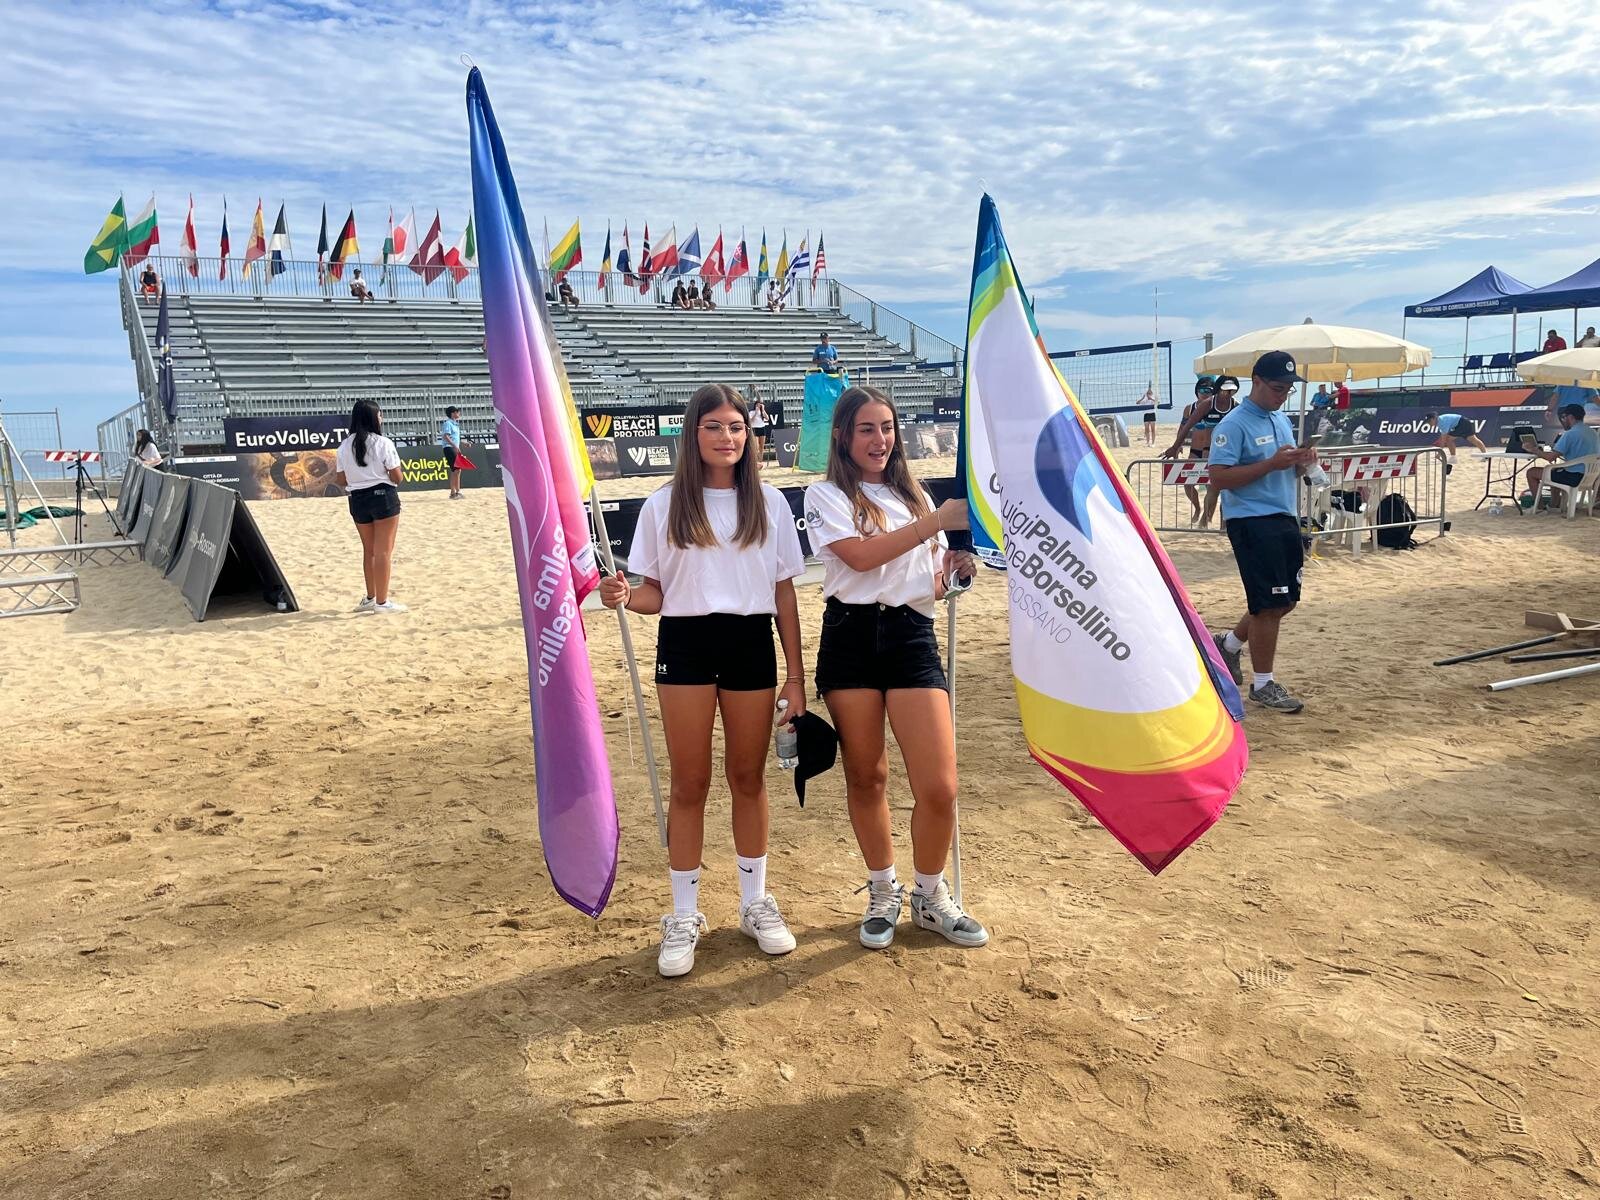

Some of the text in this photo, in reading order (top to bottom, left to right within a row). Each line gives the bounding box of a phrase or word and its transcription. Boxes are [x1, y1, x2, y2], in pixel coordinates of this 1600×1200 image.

[613, 419, 656, 431] BEACH
[235, 428, 350, 447] EuroVolley.T
[632, 429, 656, 437] TOUR
[400, 457, 450, 471] Volleyb
[402, 469, 449, 482] World
